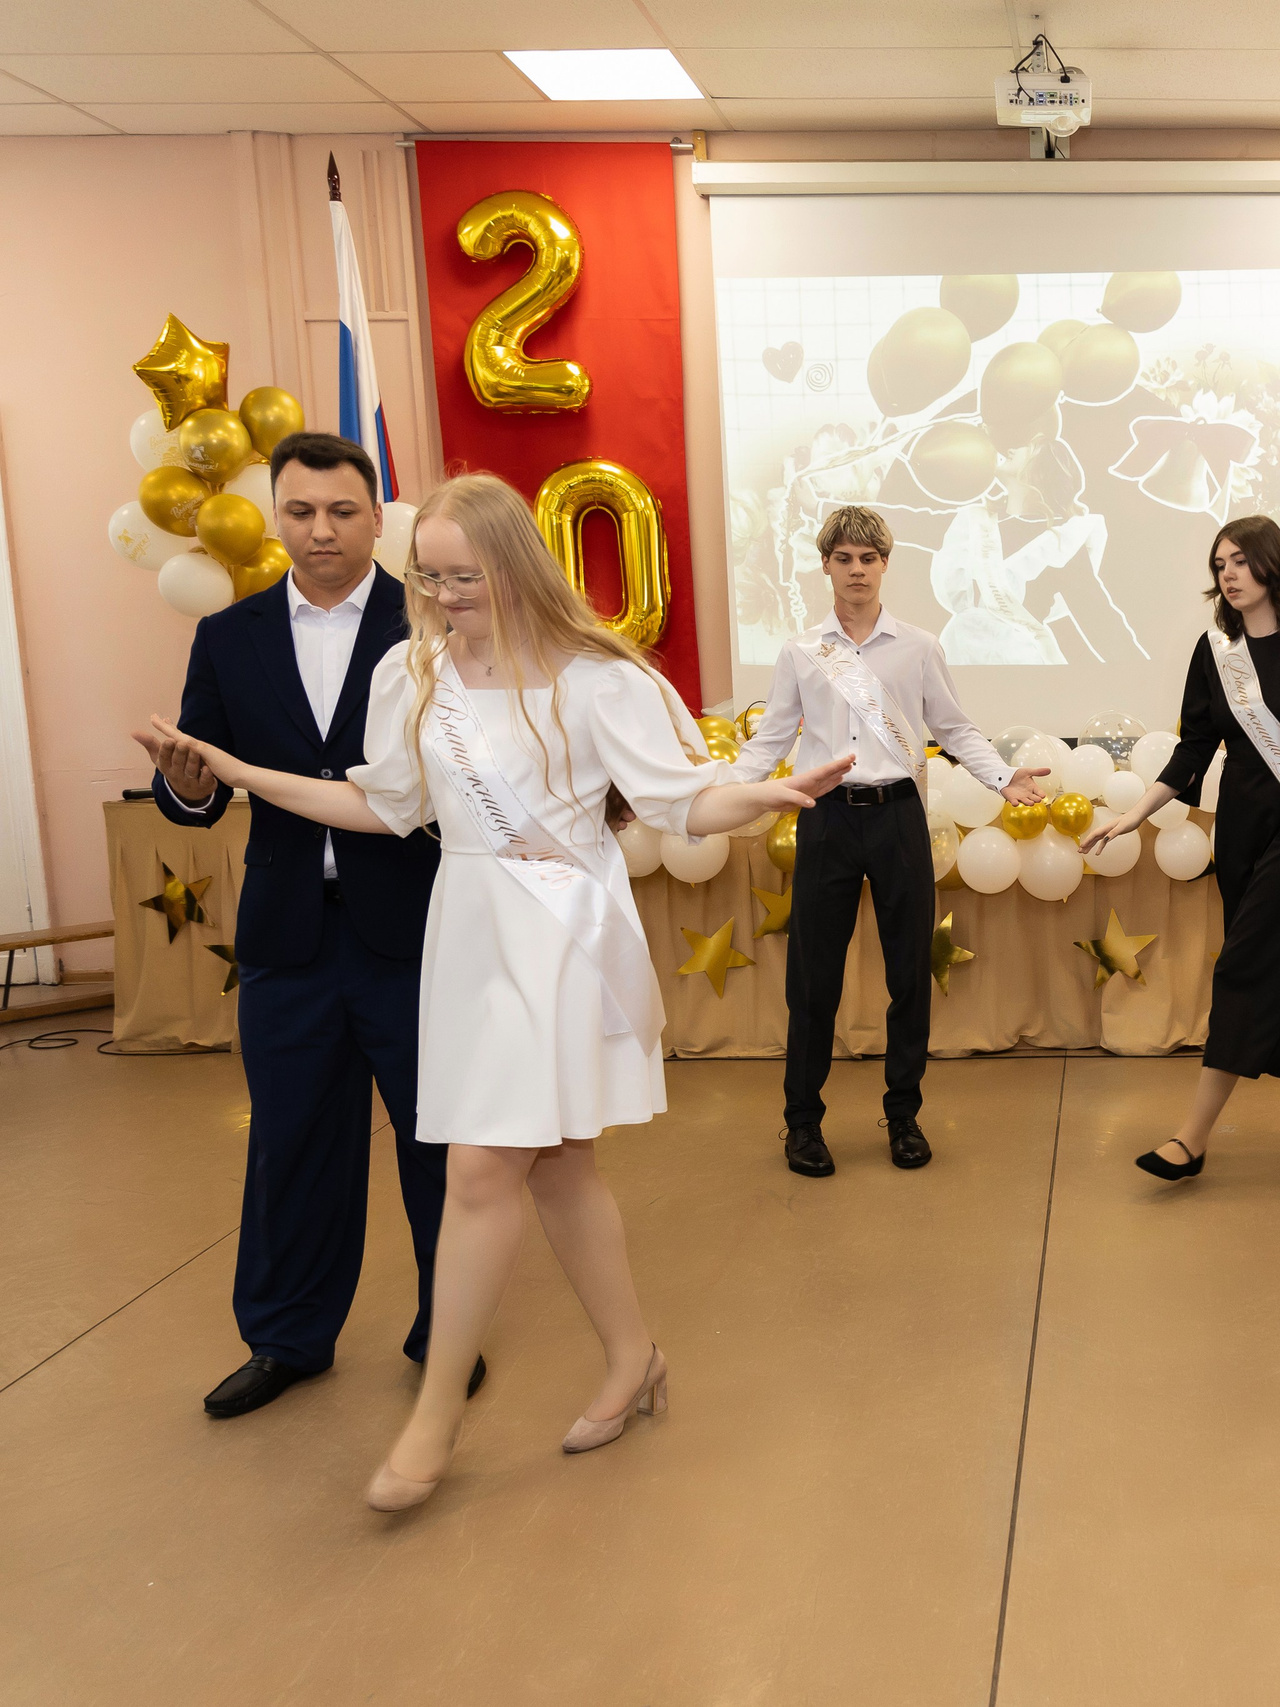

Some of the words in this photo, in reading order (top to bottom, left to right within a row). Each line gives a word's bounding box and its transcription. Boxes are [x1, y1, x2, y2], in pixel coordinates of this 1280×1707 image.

[457, 189, 593, 414] 2
[535, 456, 671, 650] 0
[433, 679, 529, 846] Выпускница
[515, 847, 586, 890] 2026
